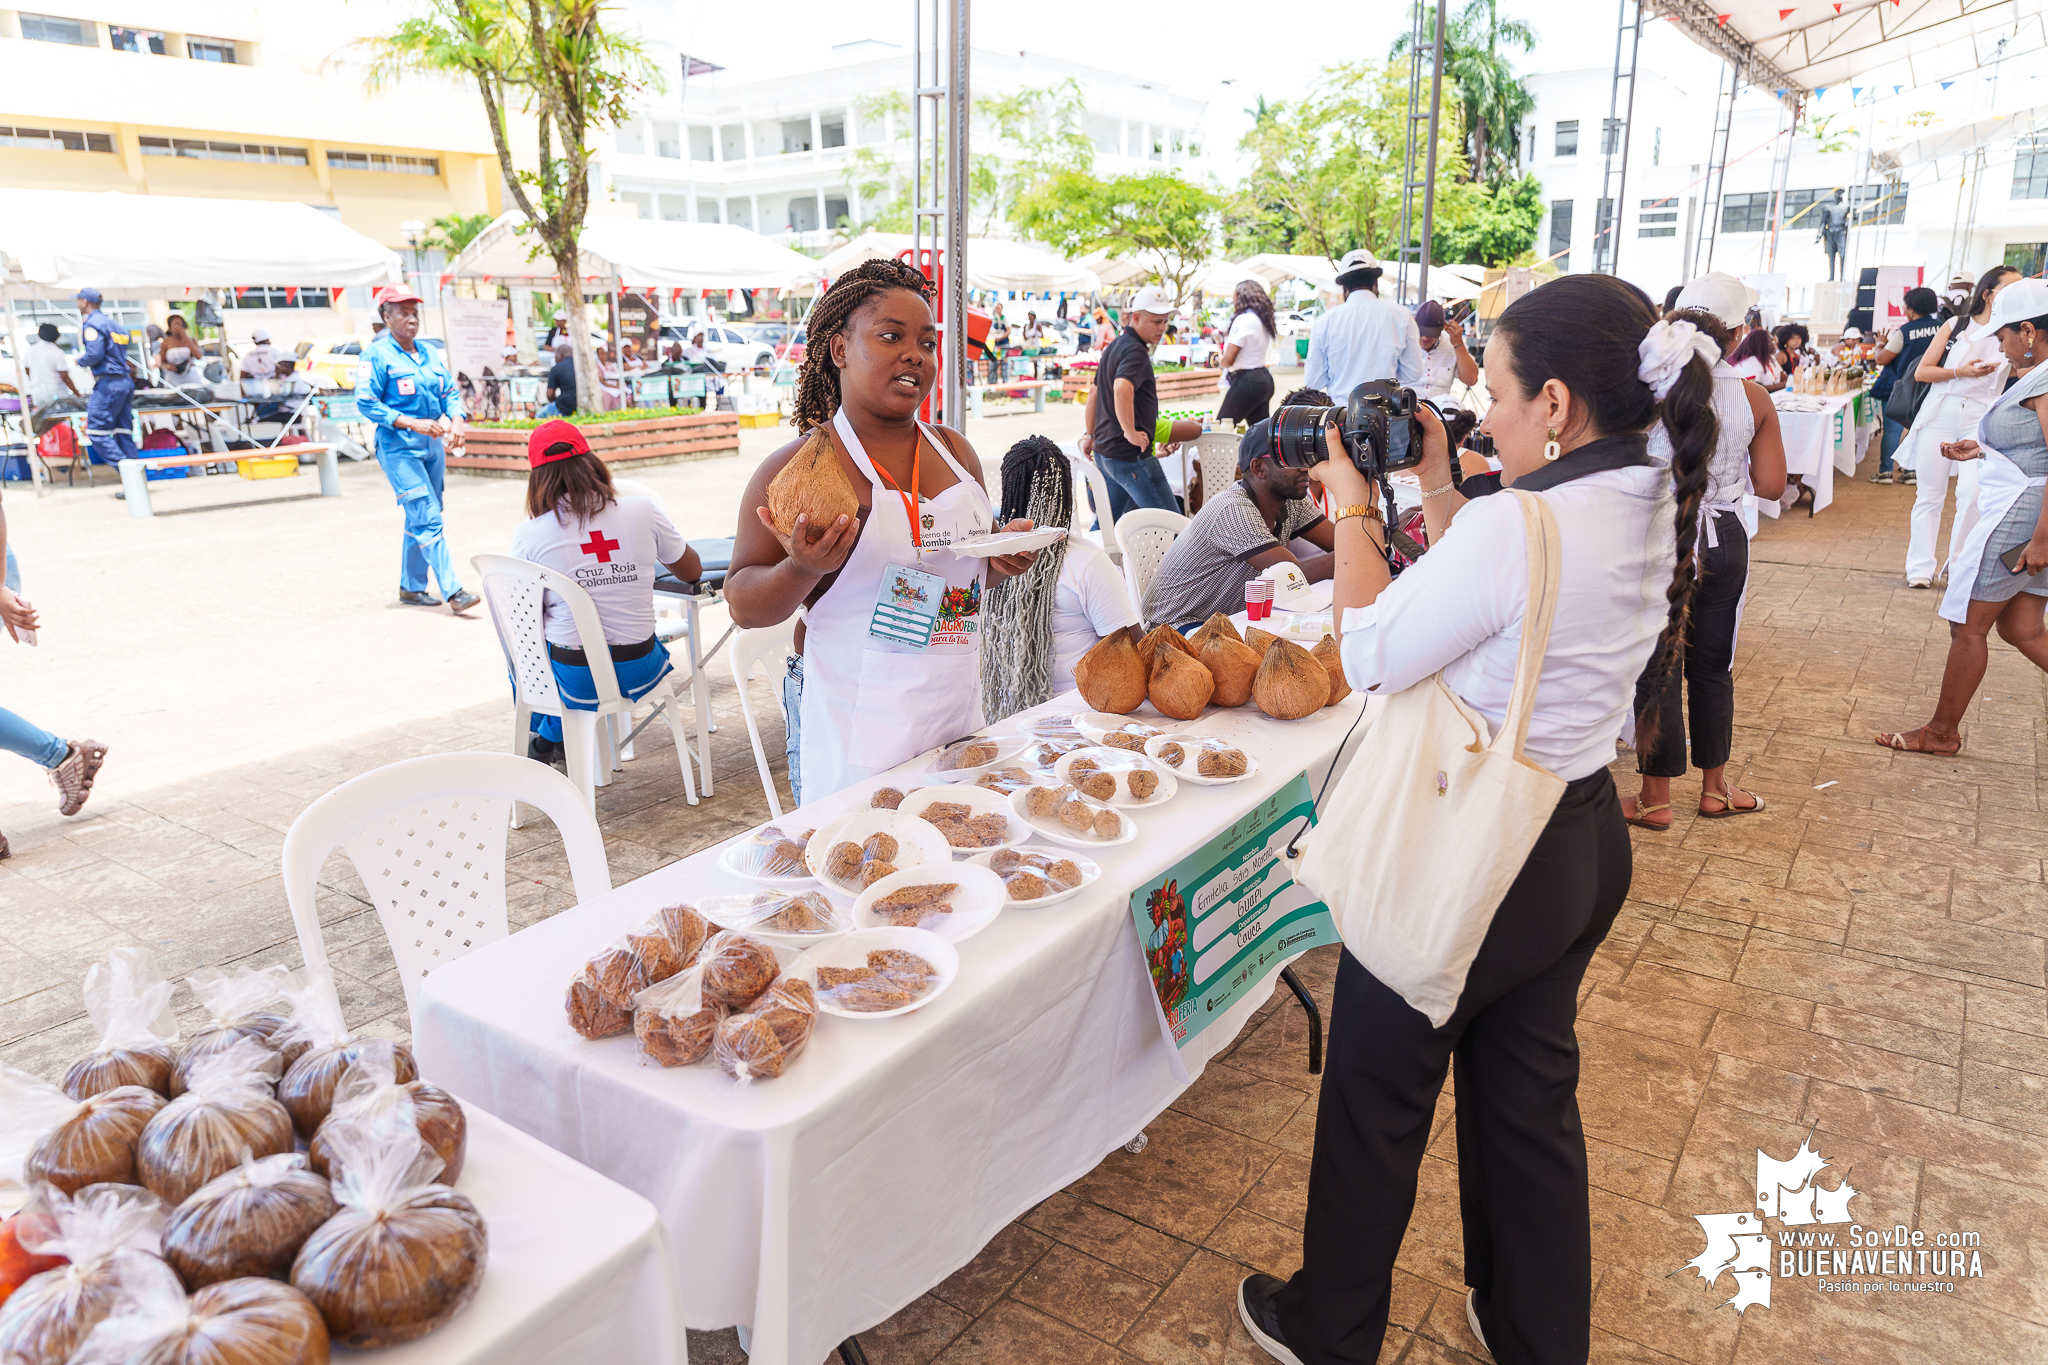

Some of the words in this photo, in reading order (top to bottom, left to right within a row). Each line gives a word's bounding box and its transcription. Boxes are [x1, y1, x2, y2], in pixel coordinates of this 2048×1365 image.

[911, 538, 951, 547] Clombia
[575, 568, 604, 578] Cruz
[611, 562, 636, 574] Roja
[577, 573, 638, 588] Colombiana
[1242, 846, 1260, 862] Nombre
[1242, 877, 1261, 894] Municipio
[1238, 903, 1268, 930] Departamento
